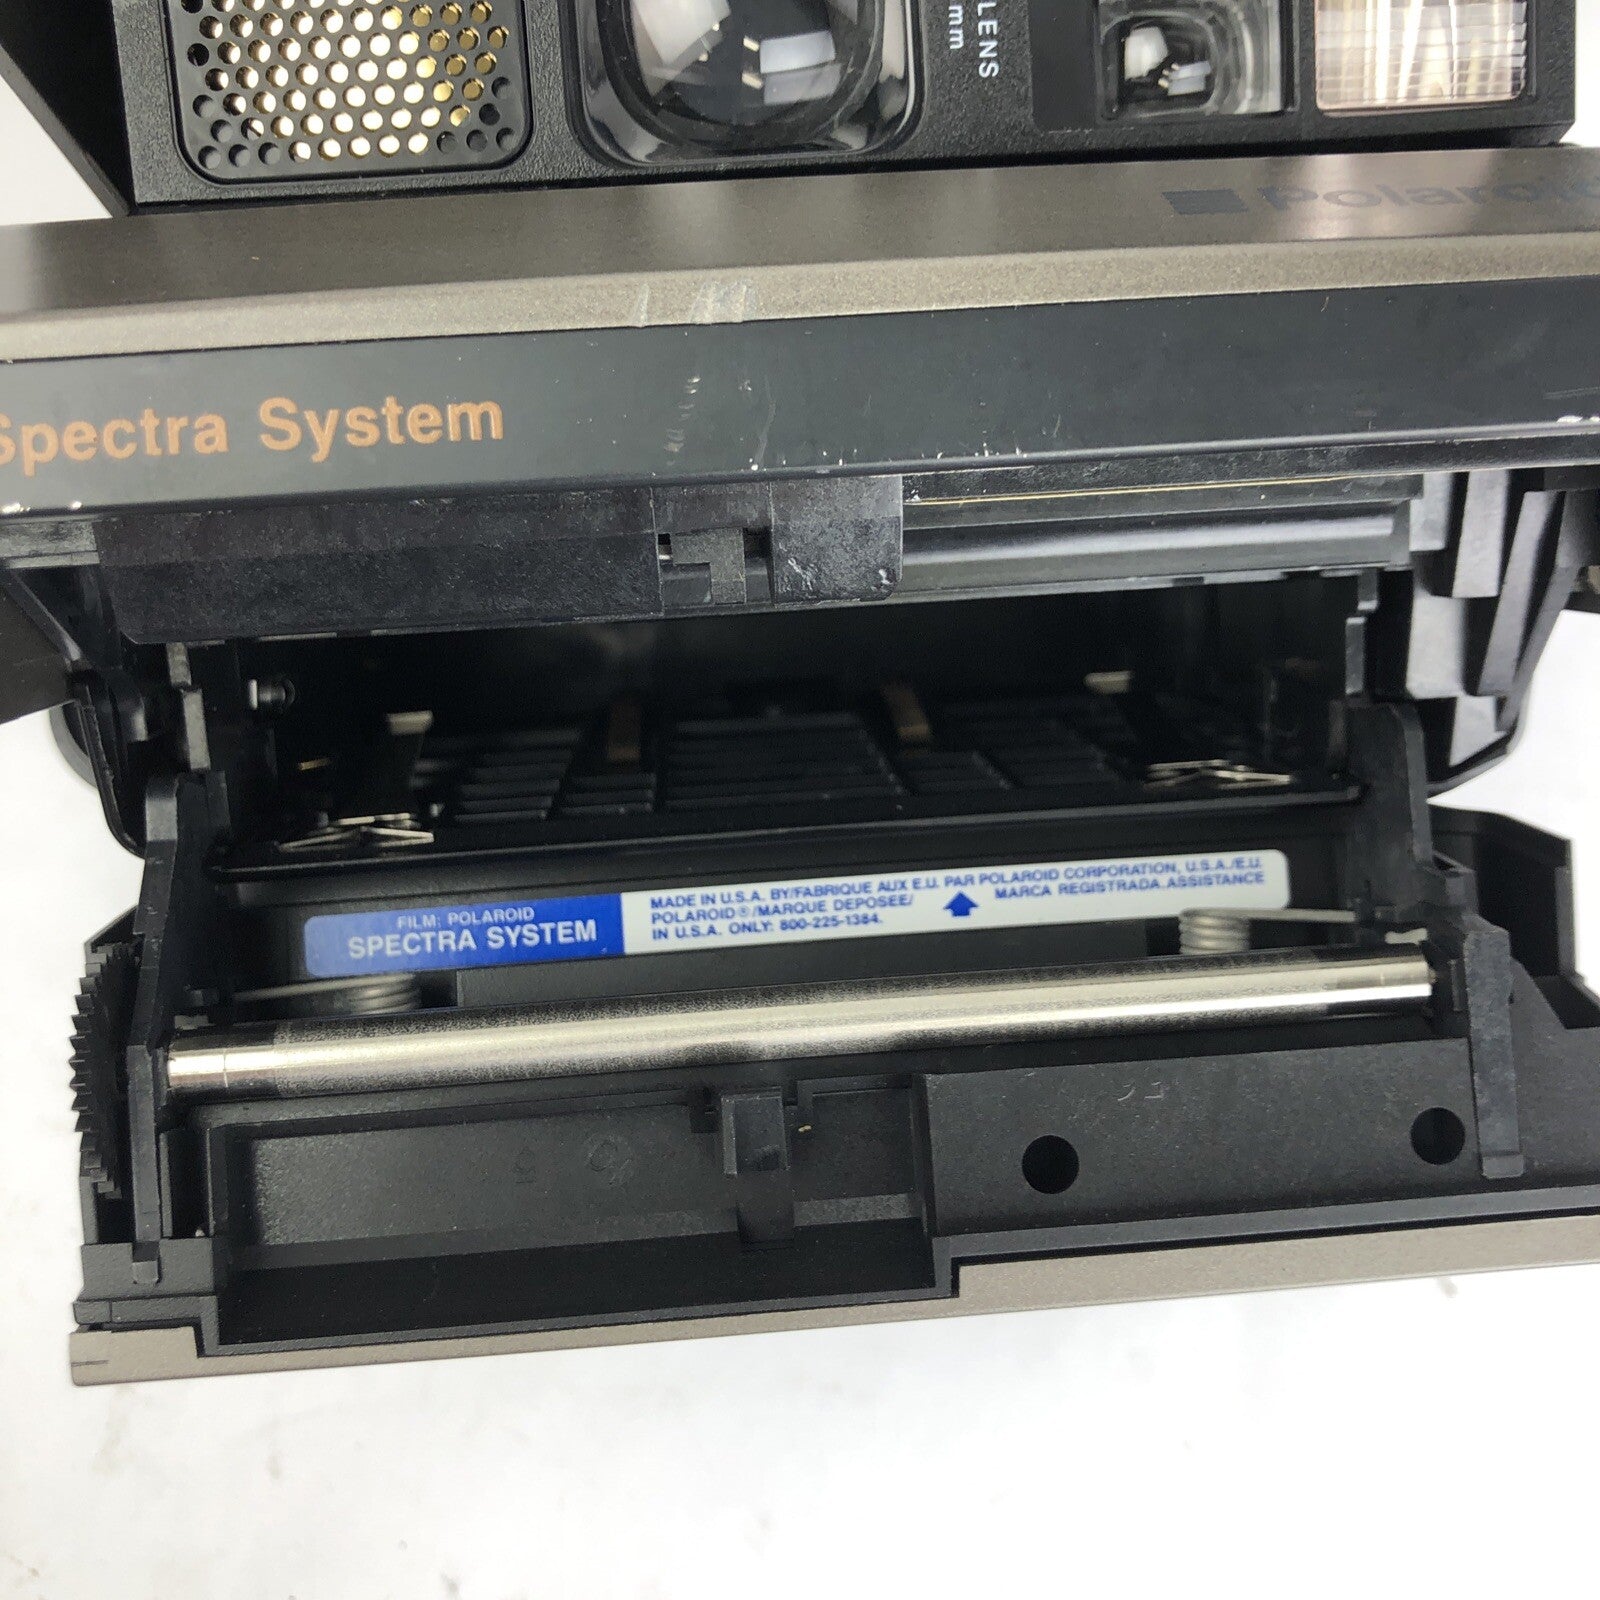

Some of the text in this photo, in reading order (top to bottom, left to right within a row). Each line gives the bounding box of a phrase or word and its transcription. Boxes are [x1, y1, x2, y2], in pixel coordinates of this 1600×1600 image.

[977, 1, 999, 78] LENS
[258, 395, 504, 463] System
[650, 894, 696, 909] MADE
[701, 892, 716, 905] IN
[720, 890, 766, 904] U.S.A.
[770, 881, 872, 900] BY/FABRIQUE
[877, 879, 907, 893] AUX
[912, 877, 939, 889] E.U.
[944, 873, 975, 887] PAR
[979, 868, 1060, 885] POLAROID
[994, 883, 1053, 899] MARCA
[1166, 870, 1265, 888] ASSISTANCE
[447, 906, 535, 925] POLAROID
[652, 928, 668, 940] IN
[675, 923, 722, 938] U.S.A.
[348, 918, 597, 960] SPECTRA SYSTEM
